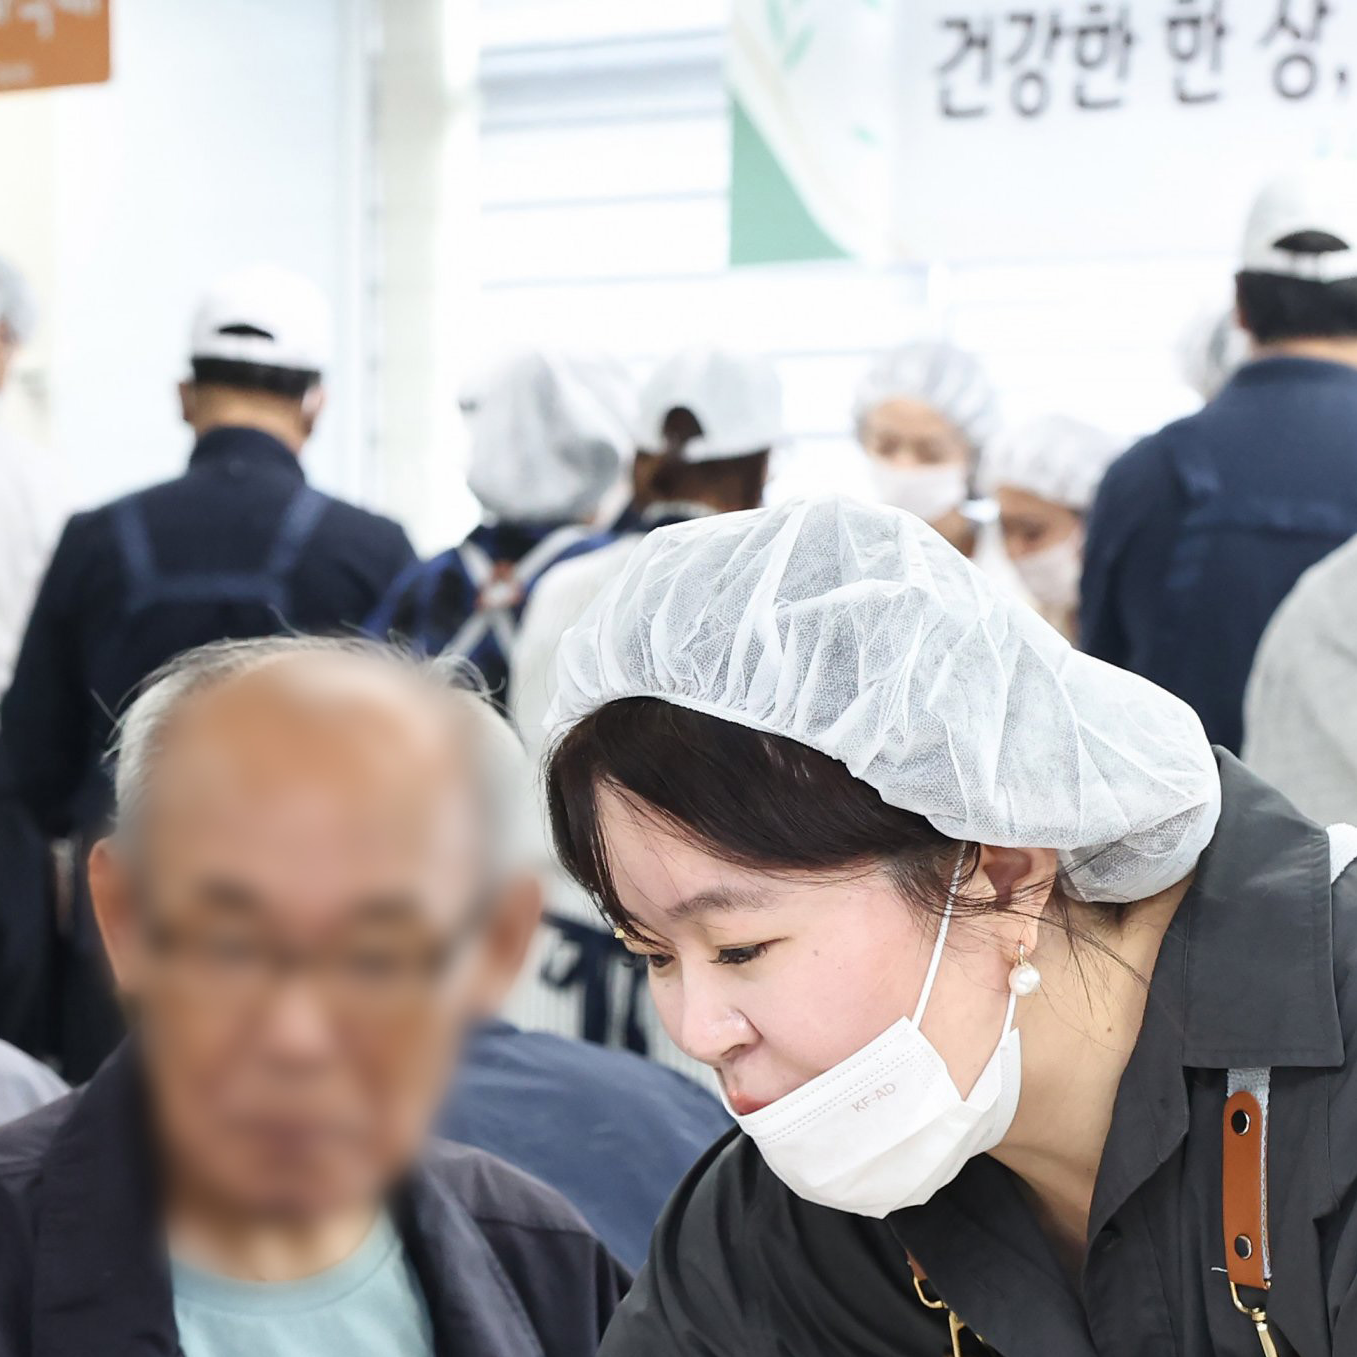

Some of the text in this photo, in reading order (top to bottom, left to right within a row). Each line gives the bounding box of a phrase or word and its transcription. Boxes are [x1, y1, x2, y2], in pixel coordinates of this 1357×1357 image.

[936, 3, 1133, 118] 건강한
[1166, 0, 1226, 104] 한
[851, 1082, 897, 1113] KF-AD
